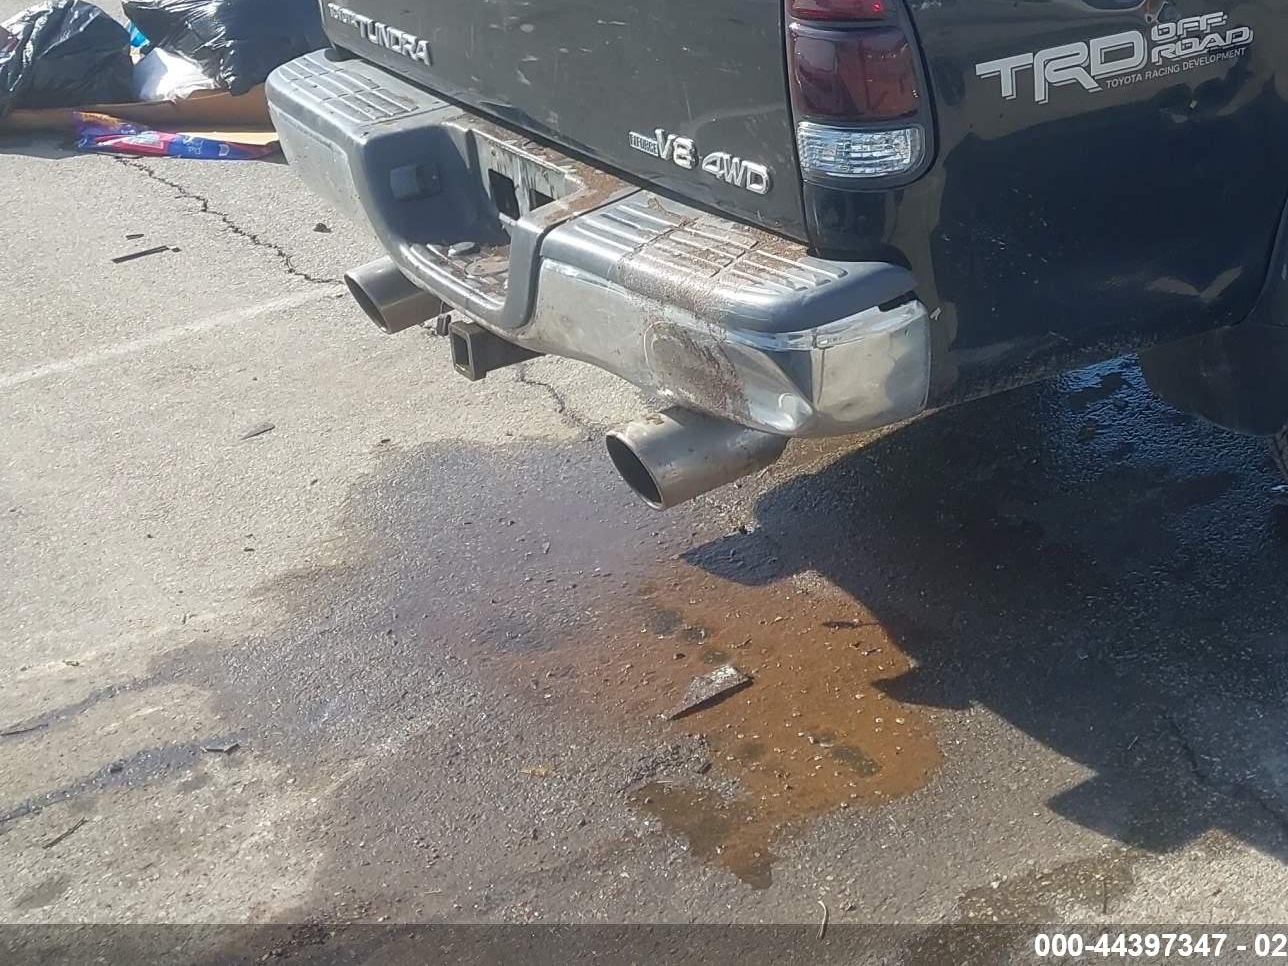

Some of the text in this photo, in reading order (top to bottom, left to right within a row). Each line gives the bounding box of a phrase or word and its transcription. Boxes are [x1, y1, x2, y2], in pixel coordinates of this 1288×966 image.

[356, 14, 430, 66] TUNDRA
[1151, 11, 1228, 43] OFF
[1151, 26, 1254, 65] ROAD
[975, 30, 1149, 105] TRD
[1105, 47, 1247, 90] TOYOTA RACING DEVELOPMENT
[655, 128, 699, 170] V8
[702, 151, 770, 195] 4WD
